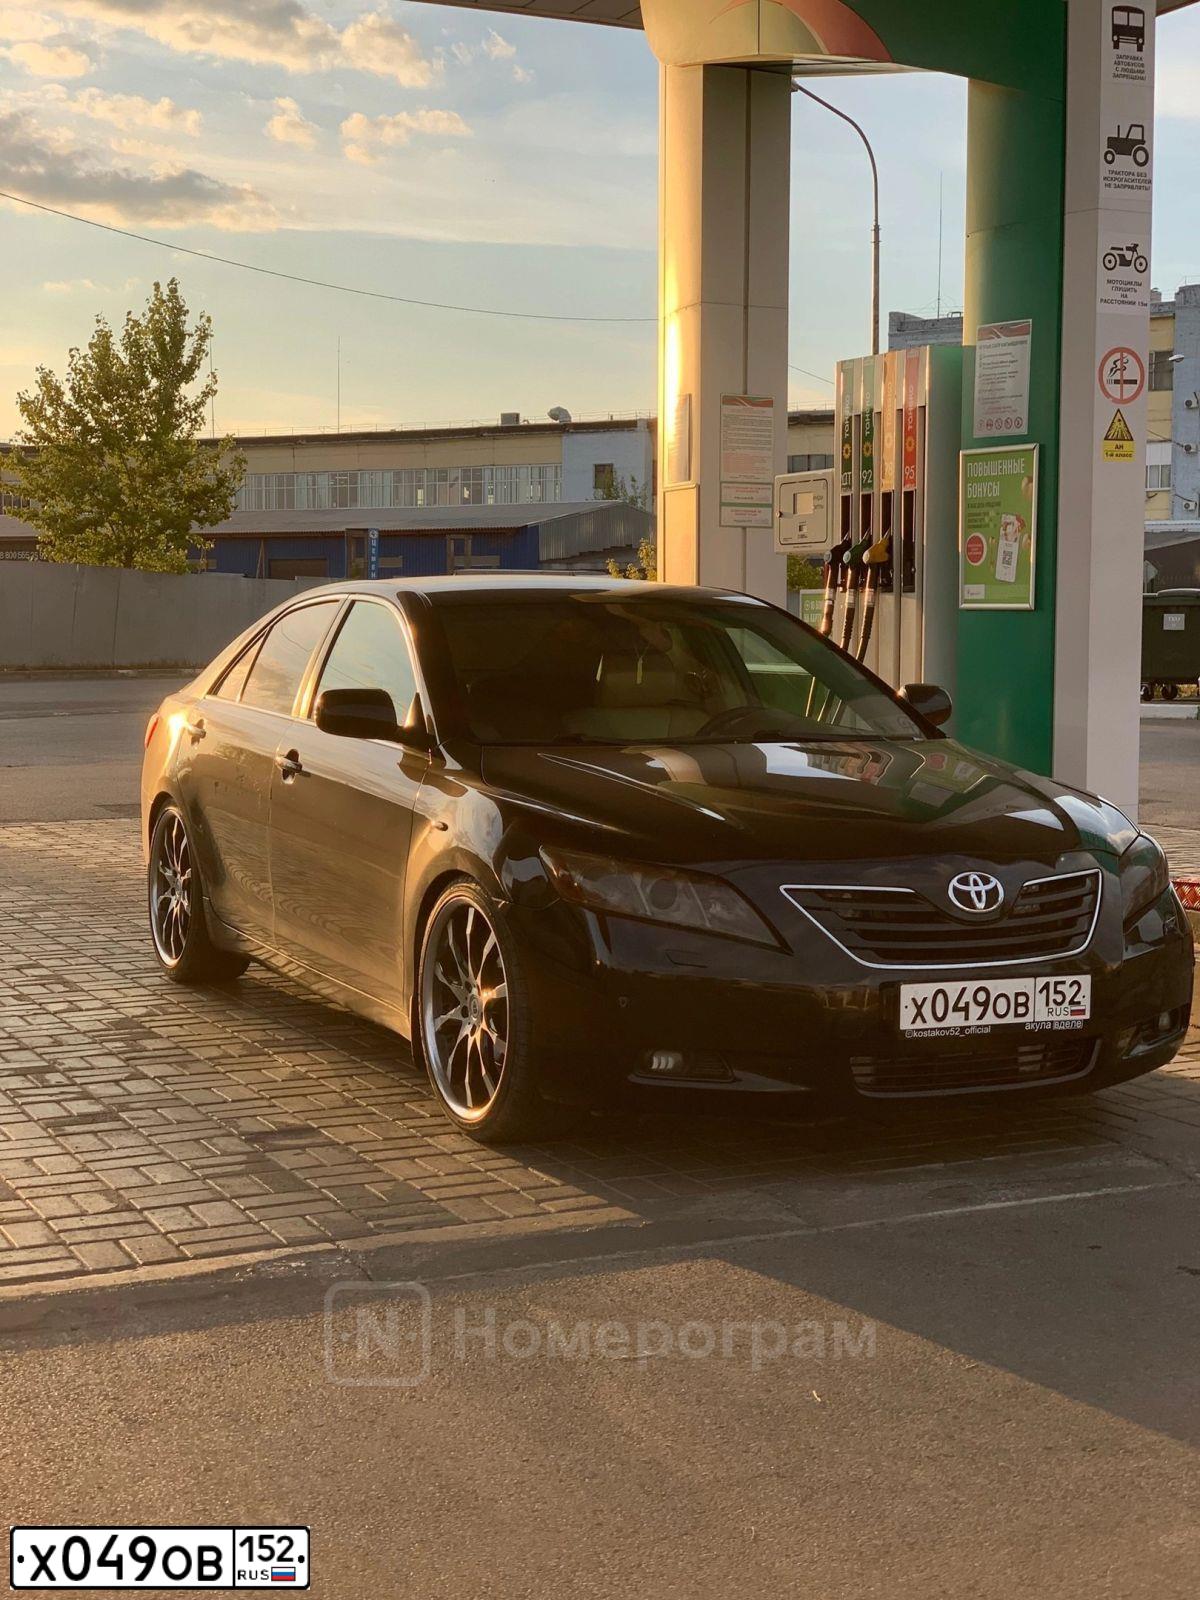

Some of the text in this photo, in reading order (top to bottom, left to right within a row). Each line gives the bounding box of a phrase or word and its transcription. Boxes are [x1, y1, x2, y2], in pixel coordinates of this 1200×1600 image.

[1114, 60, 1145, 68] АВТОБУСОВ
[1108, 169, 1135, 177] ТРАКТОРА
[1107, 279, 1142, 287] МОТОЦИКЛЫ
[904, 465, 915, 480] 95
[967, 457, 1025, 478] ПОВЫШЕННЫЕ
[862, 469, 873, 484] 92
[967, 481, 1000, 498] БОНУСЫ
[910, 979, 1082, 1025] Х049ОВ 152
[1047, 1006, 1069, 1017] RUS
[1025, 1021, 1052, 1032] акула
